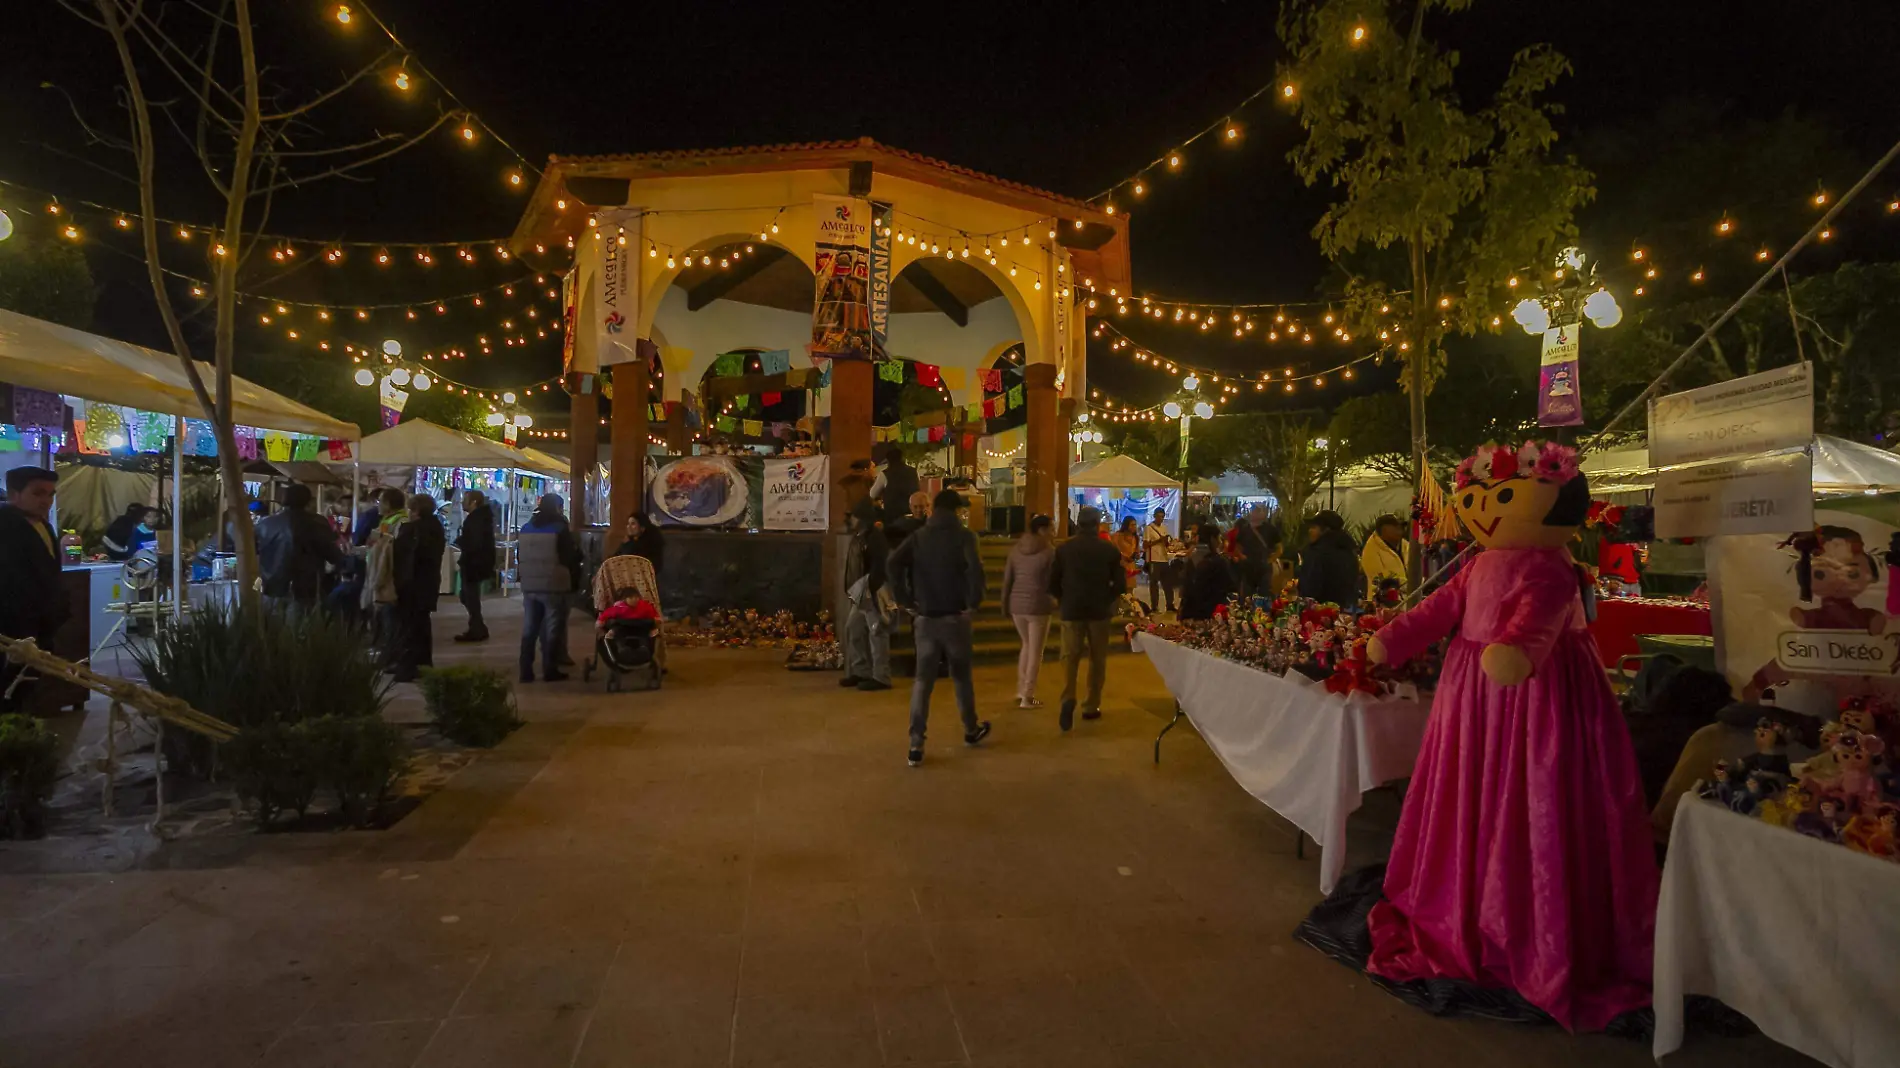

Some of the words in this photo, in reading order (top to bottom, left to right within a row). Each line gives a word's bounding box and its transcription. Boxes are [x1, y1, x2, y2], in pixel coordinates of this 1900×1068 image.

[872, 226, 890, 337] ARTESANÍAS
[1786, 640, 1820, 658] San
[1828, 641, 1884, 661] Diego
